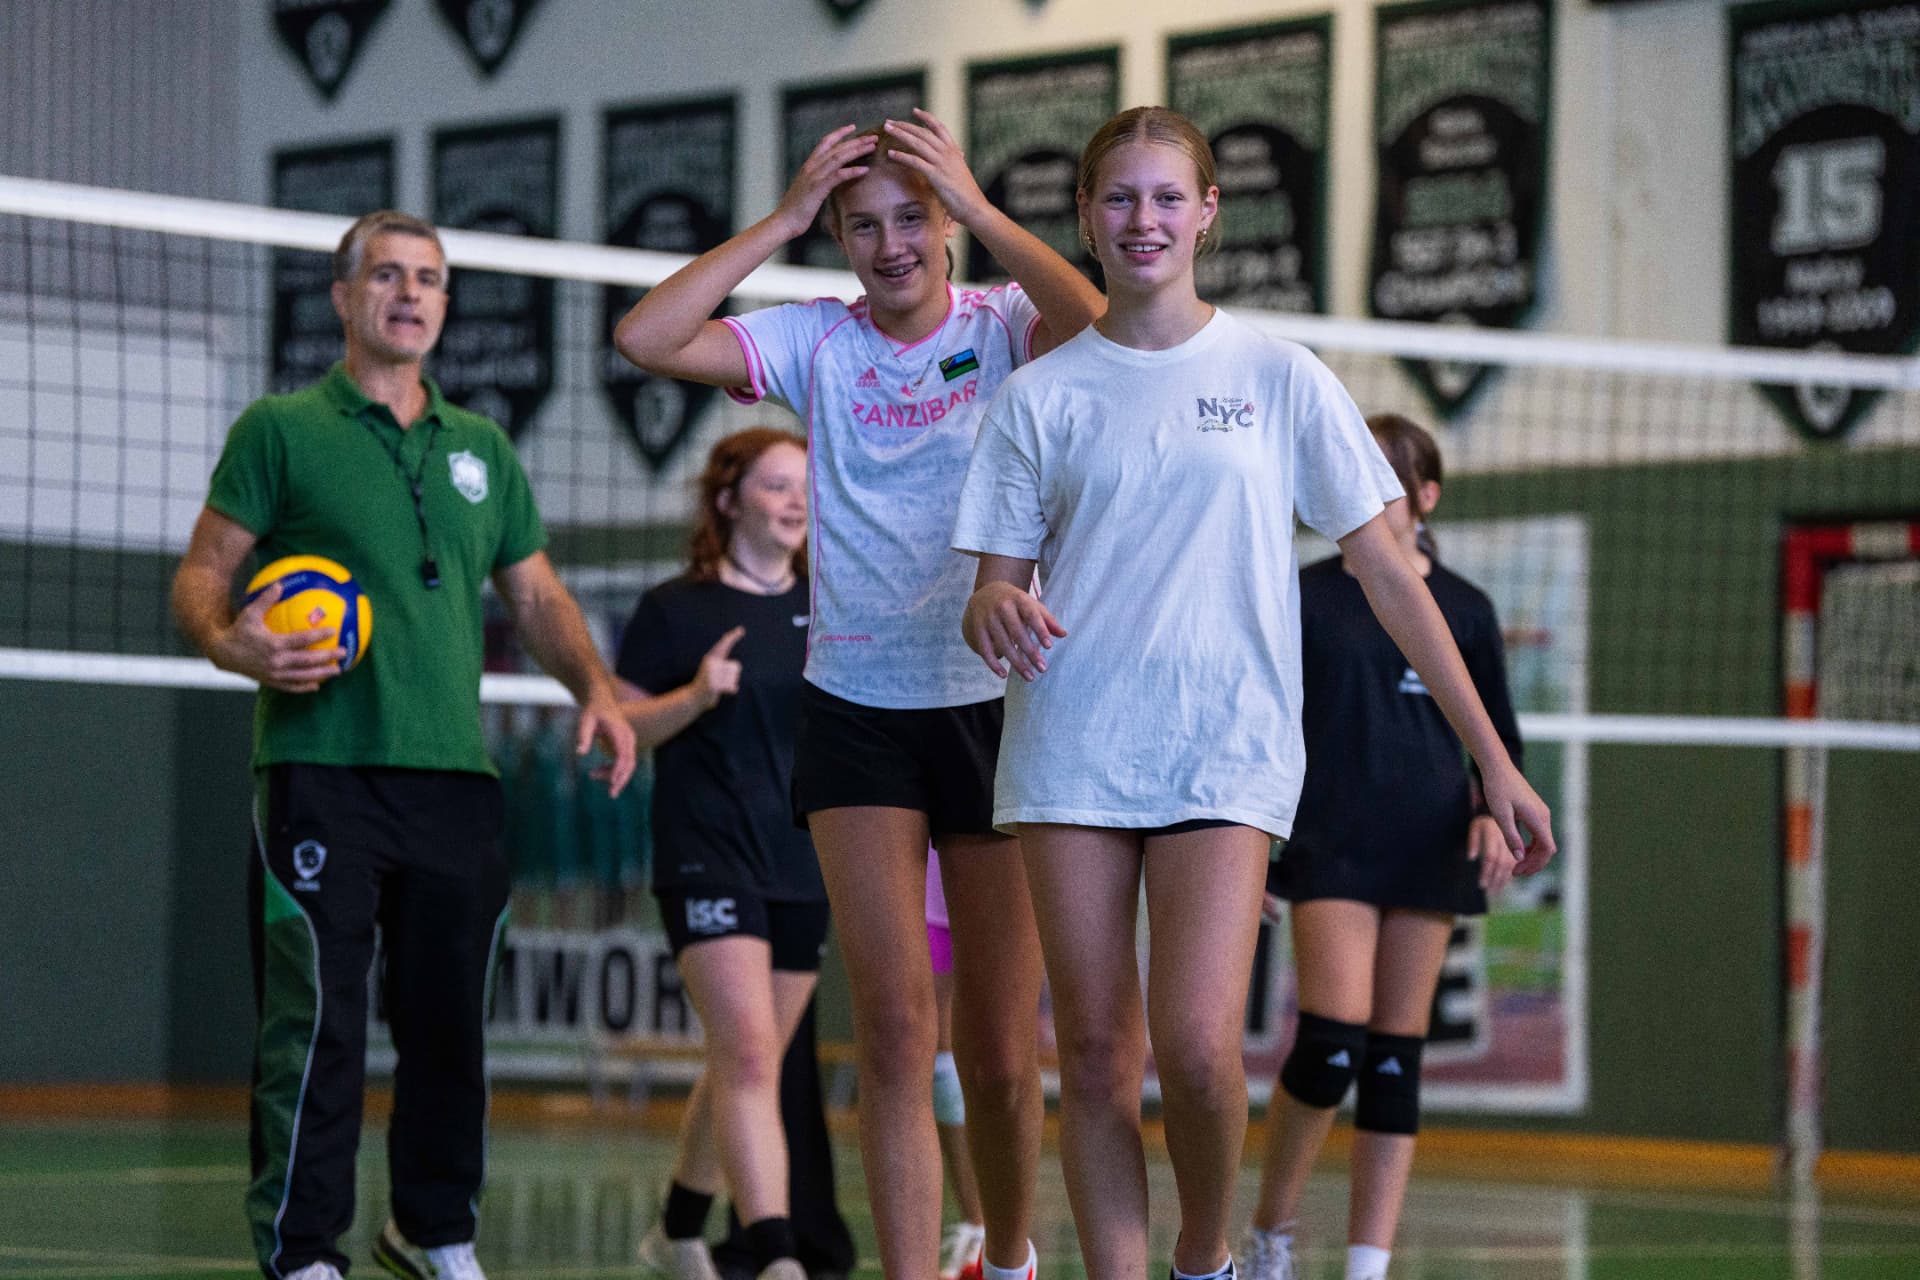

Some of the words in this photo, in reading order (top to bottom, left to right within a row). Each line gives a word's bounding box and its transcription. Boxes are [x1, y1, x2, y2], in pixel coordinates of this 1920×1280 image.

[1770, 137, 1886, 257] 15
[852, 378, 978, 427] ZANZIBAR
[1197, 398, 1254, 428] NYC
